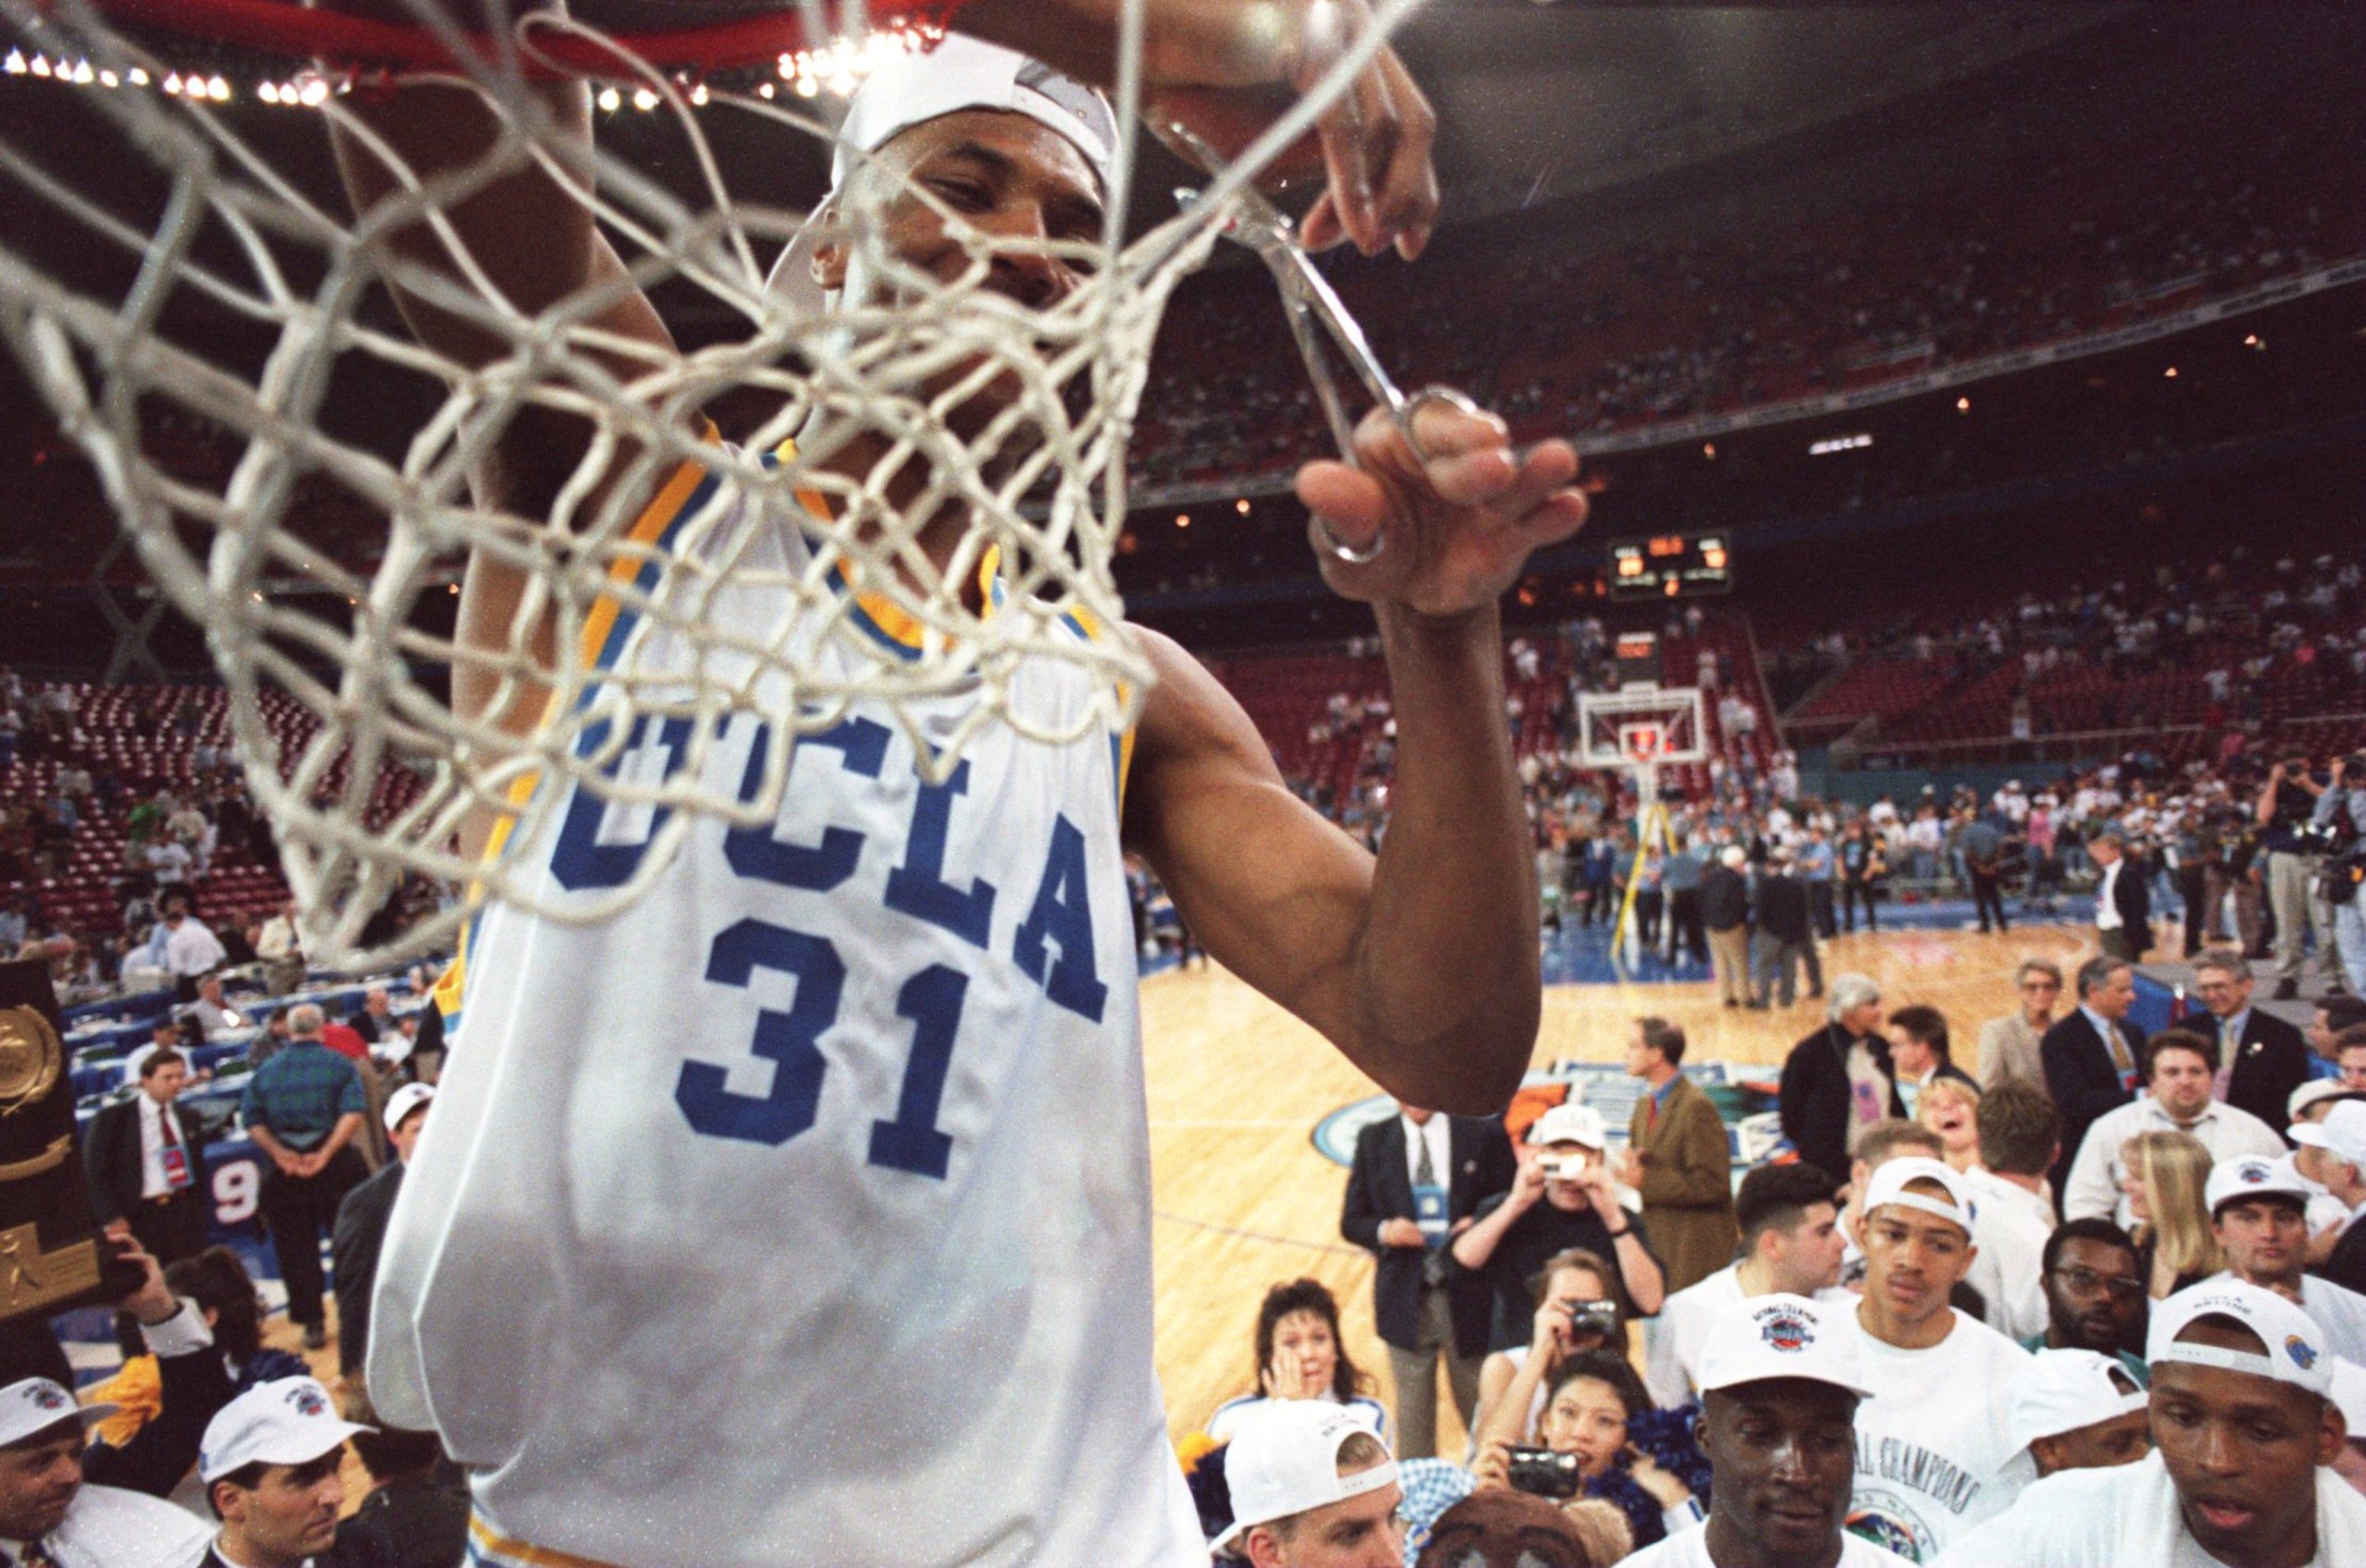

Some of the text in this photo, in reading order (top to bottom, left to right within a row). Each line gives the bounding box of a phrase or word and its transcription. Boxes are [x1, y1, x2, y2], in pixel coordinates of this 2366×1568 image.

[549, 704, 1108, 1026] UCLA
[675, 917, 970, 1180] 31
[212, 1160, 261, 1224] 9
